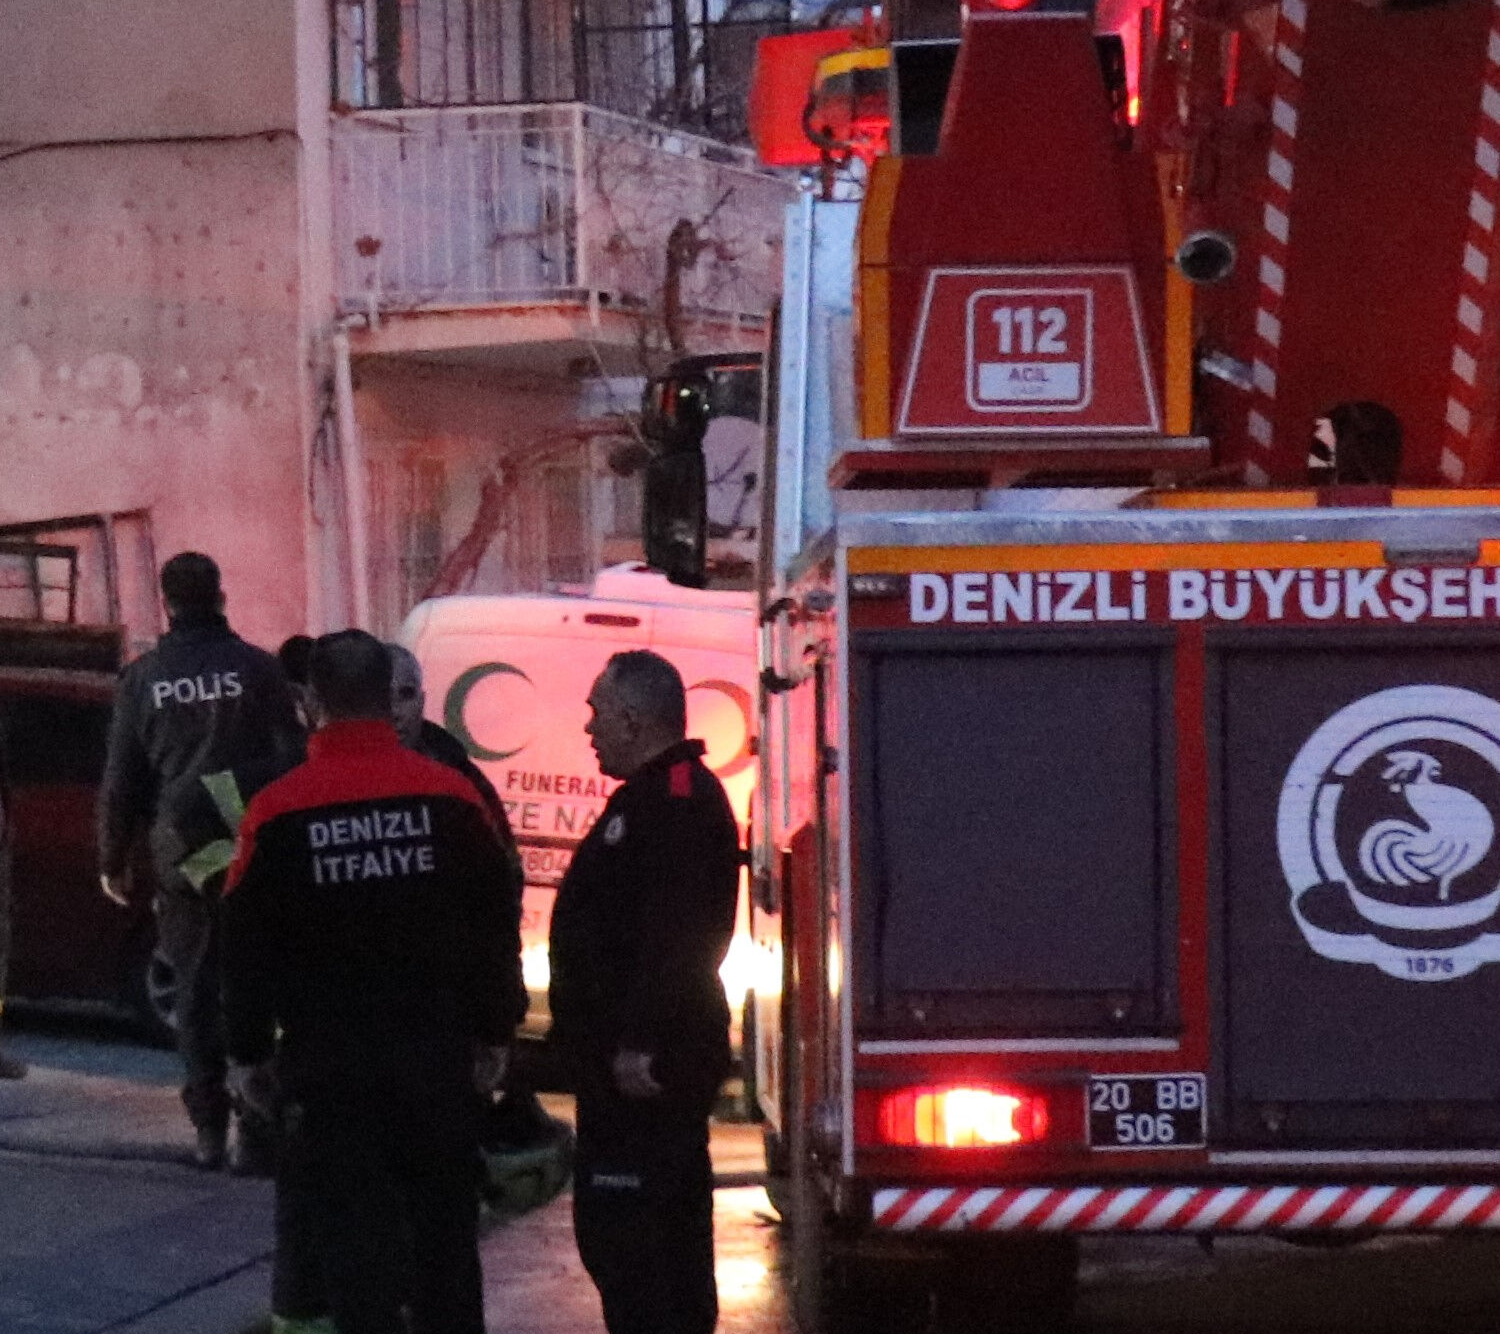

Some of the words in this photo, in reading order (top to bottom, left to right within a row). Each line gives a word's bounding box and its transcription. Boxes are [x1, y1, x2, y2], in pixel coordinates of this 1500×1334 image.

[992, 306, 1068, 354] 112
[506, 770, 613, 798] FUNERAL
[1091, 1081, 1131, 1112] 20
[1157, 1079, 1200, 1110] BB
[1115, 1112, 1175, 1144] 506
